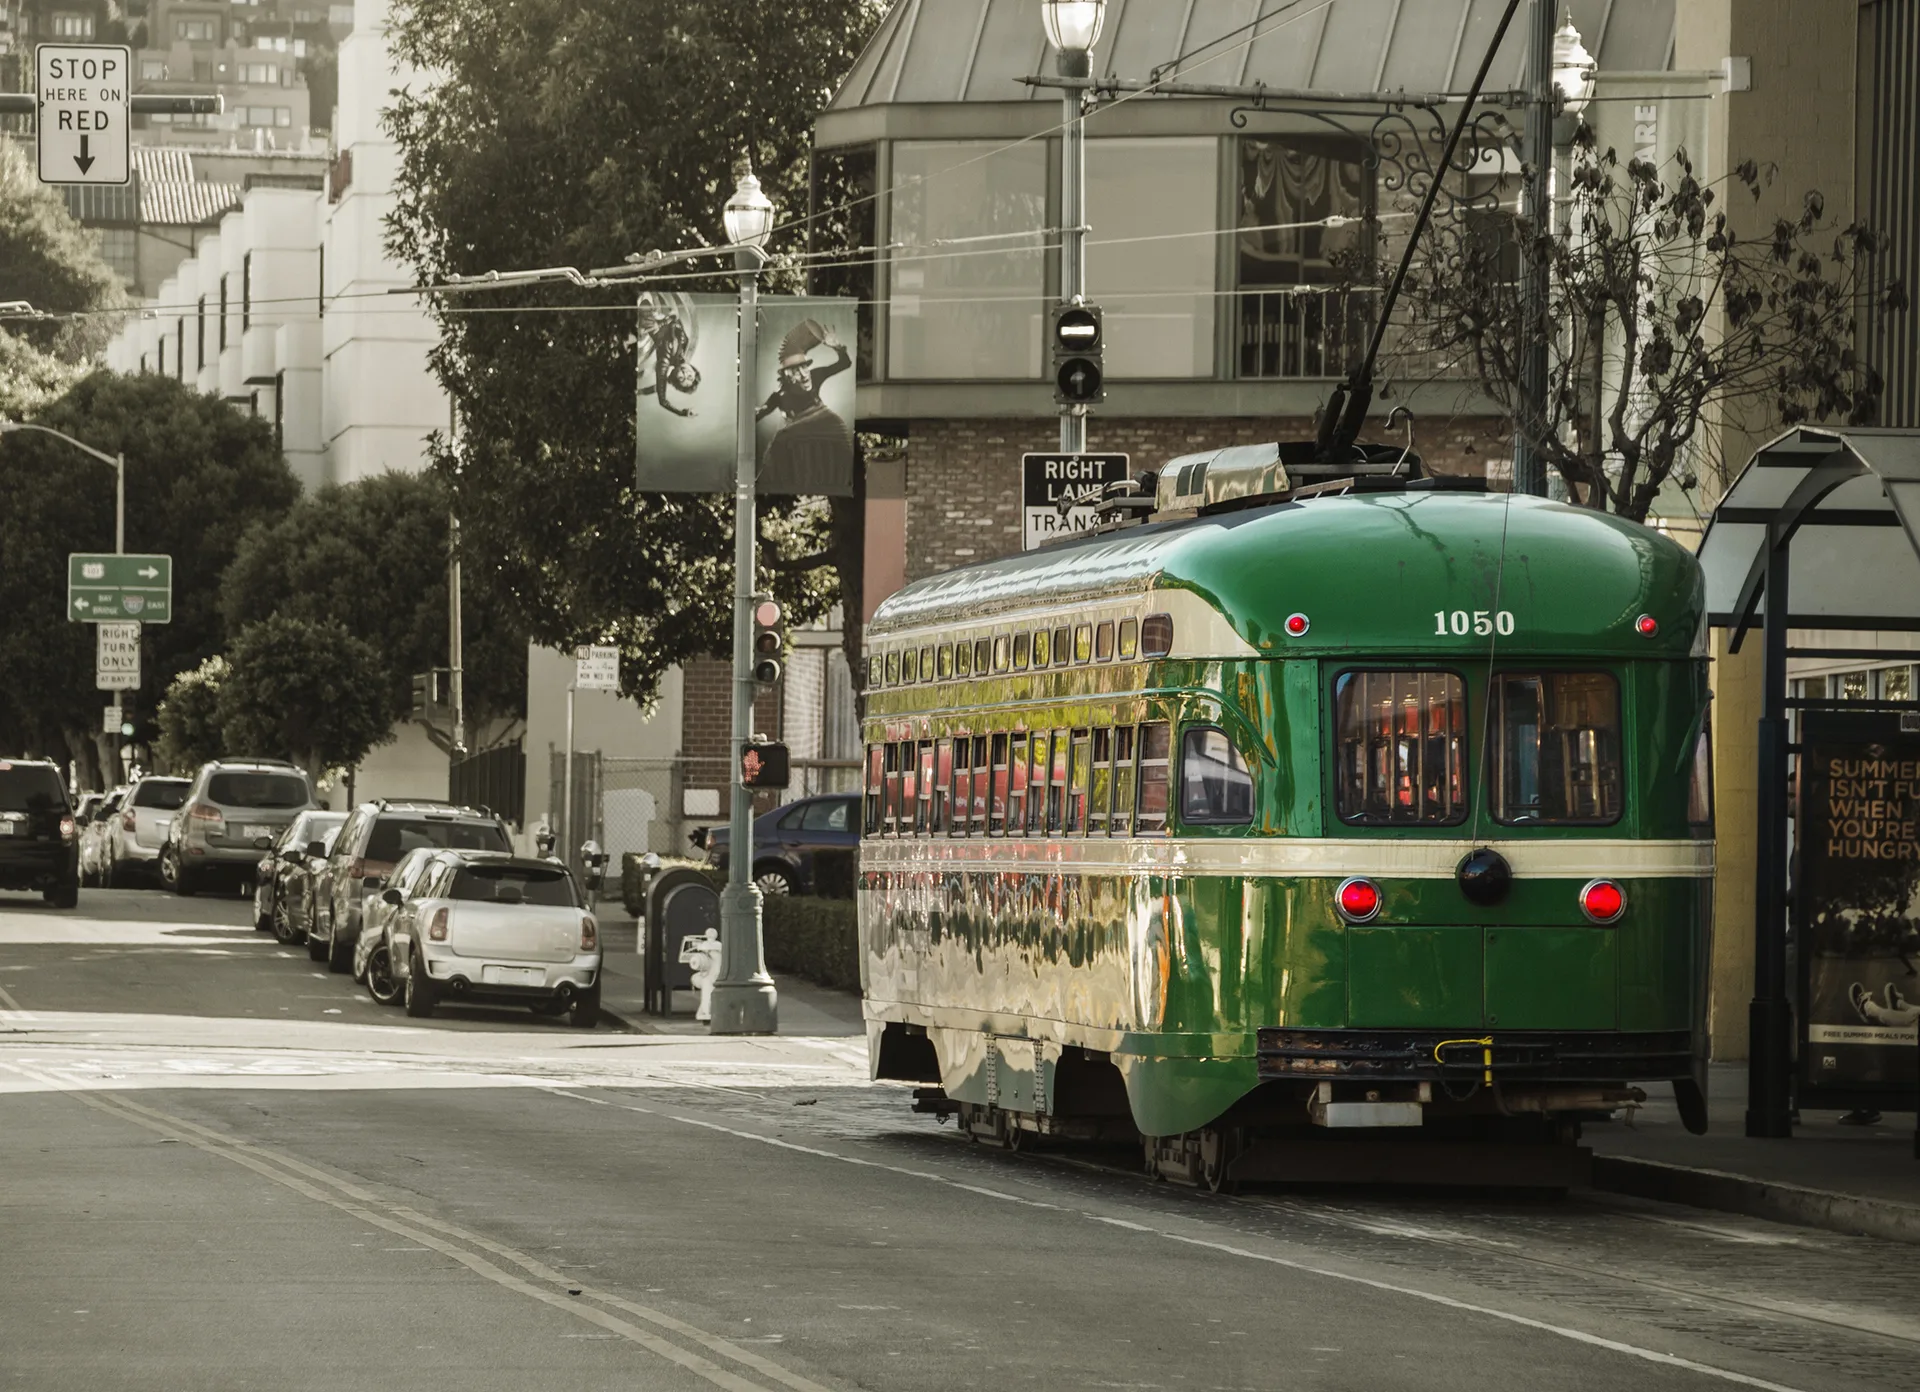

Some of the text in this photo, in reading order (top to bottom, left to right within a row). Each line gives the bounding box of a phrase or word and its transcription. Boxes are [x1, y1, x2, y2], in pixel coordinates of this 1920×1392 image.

[50, 58, 116, 80] STOP
[46, 88, 120, 101] HERE ON
[58, 110, 109, 130] RED
[1045, 461, 1106, 479] RIGHT
[1048, 483, 1103, 502] LANE
[1032, 514, 1120, 531] TRANS
[98, 594, 113, 602] BAY
[147, 601, 165, 610] EAST
[92, 606, 119, 615] BRIDGE
[1434, 610, 1515, 636] 1050
[102, 629, 136, 639] RIGHT
[103, 643, 135, 652] TURN
[578, 647, 617, 660] NO PARKING
[102, 656, 135, 667] ONLY
[1830, 759, 1920, 779] SUMME
[1830, 779, 1888, 798] ISN'T
[1829, 799, 1902, 818] WHEN
[1828, 819, 1915, 839] YOU'RE
[1875, 1032, 1899, 1040] MEALS
